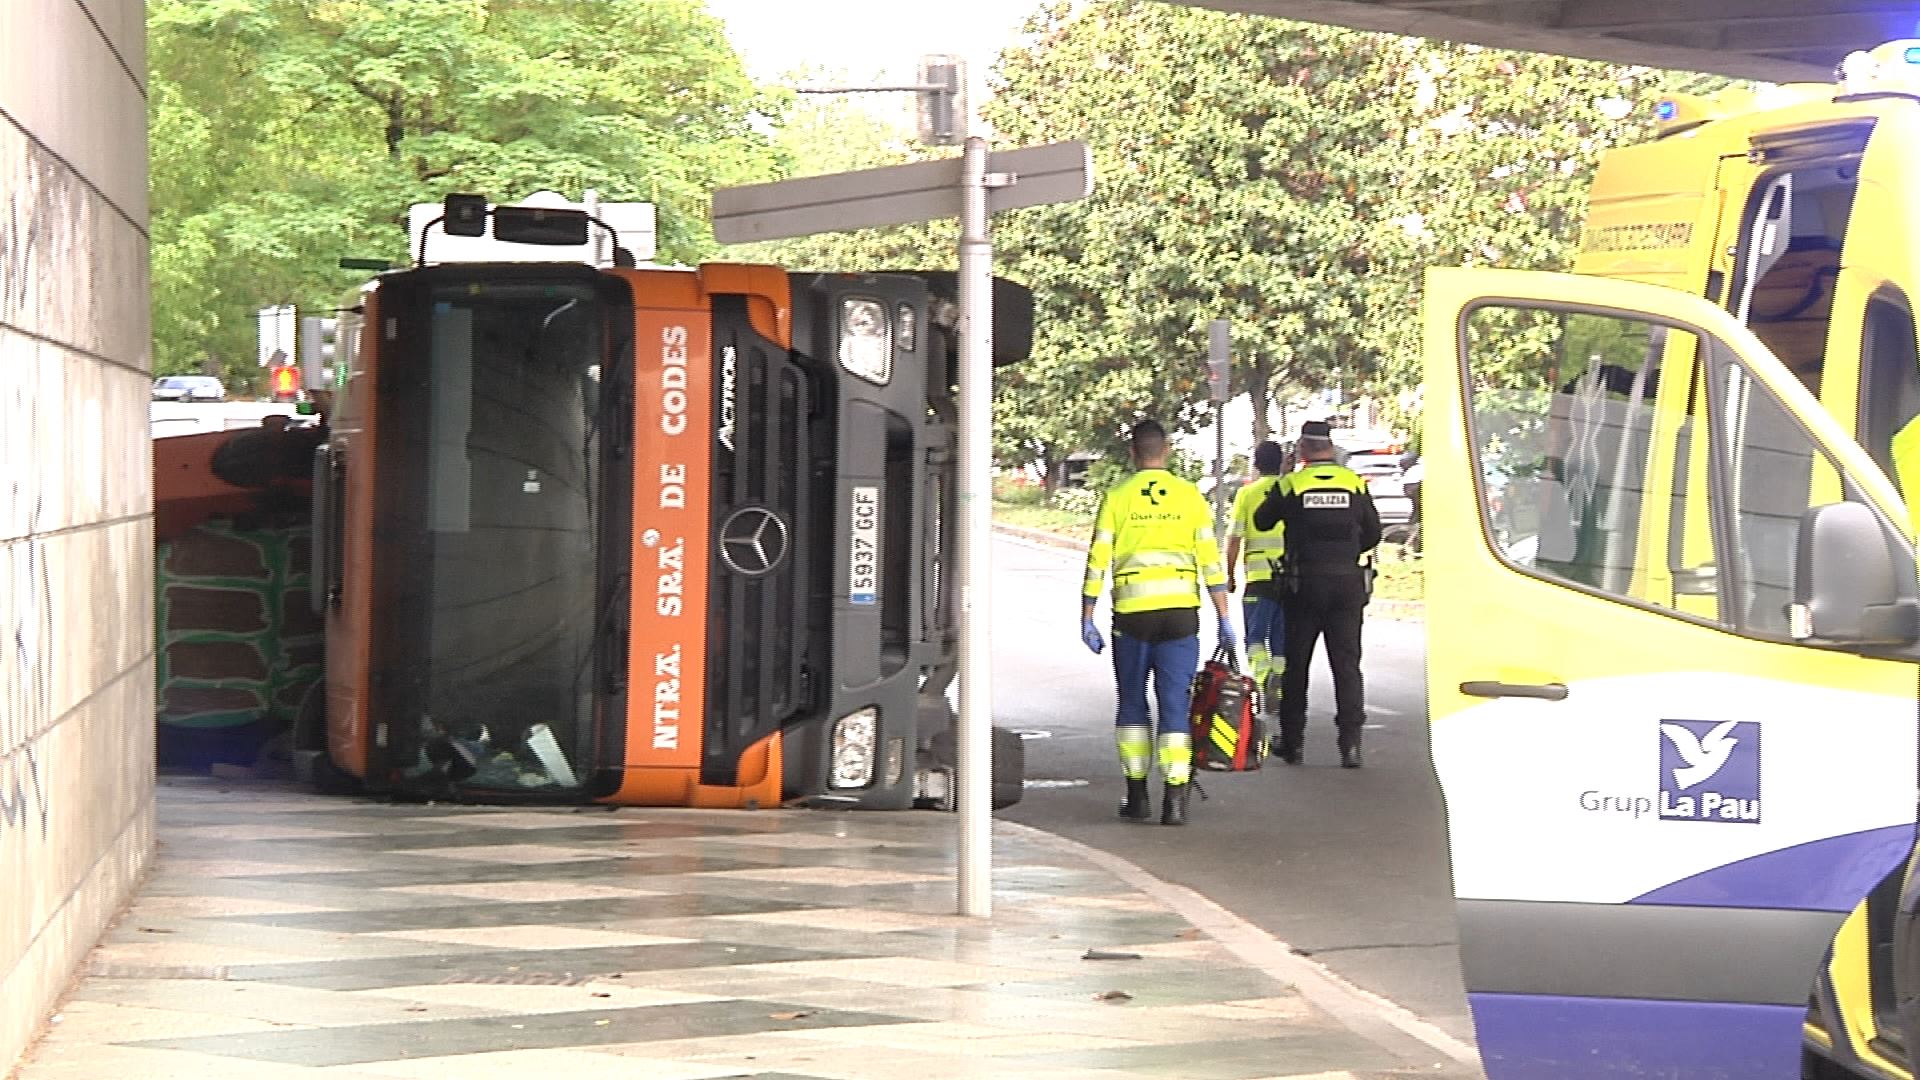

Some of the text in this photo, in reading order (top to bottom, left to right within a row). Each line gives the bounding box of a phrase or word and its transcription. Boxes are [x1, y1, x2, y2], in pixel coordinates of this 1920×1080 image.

[660, 326, 688, 435] CODES
[660, 464, 687, 508] DE
[1304, 494, 1347, 505] POLIZIA
[853, 491, 875, 588] 5937 GCF
[651, 643, 681, 750] NTRA.
[1579, 790, 1758, 820] Grup La Pau
